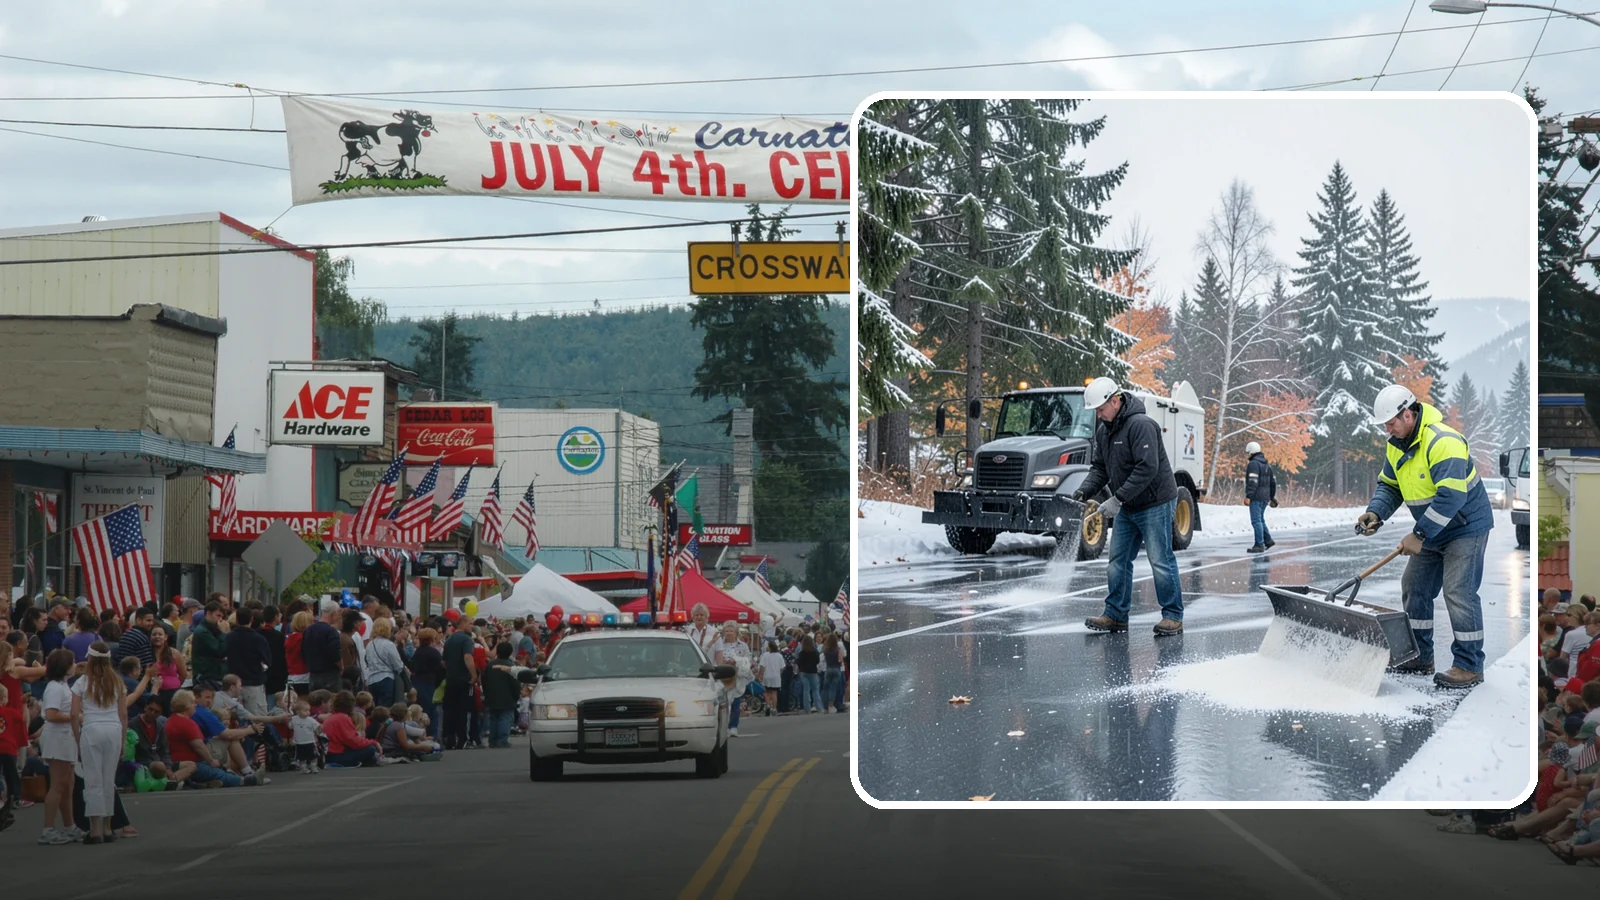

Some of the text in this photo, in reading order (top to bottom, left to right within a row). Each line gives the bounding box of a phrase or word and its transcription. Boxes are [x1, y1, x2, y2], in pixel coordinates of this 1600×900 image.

[481, 140, 605, 193] JULY
[632, 149, 746, 198] 4th.
[696, 254, 850, 280] CROSSWA
[282, 379, 374, 420] ACE
[405, 409, 453, 422] CEDAR
[283, 420, 371, 436] Hardware
[416, 427, 477, 447] Coca-Cola
[95, 485, 124, 495] Vincent
[126, 486, 135, 495] de
[138, 486, 155, 495] Paul
[81, 503, 154, 522] THT
[212, 516, 331, 536] HARDARE
[688, 526, 741, 535] CRNATION
[699, 535, 730, 543] GLASS
